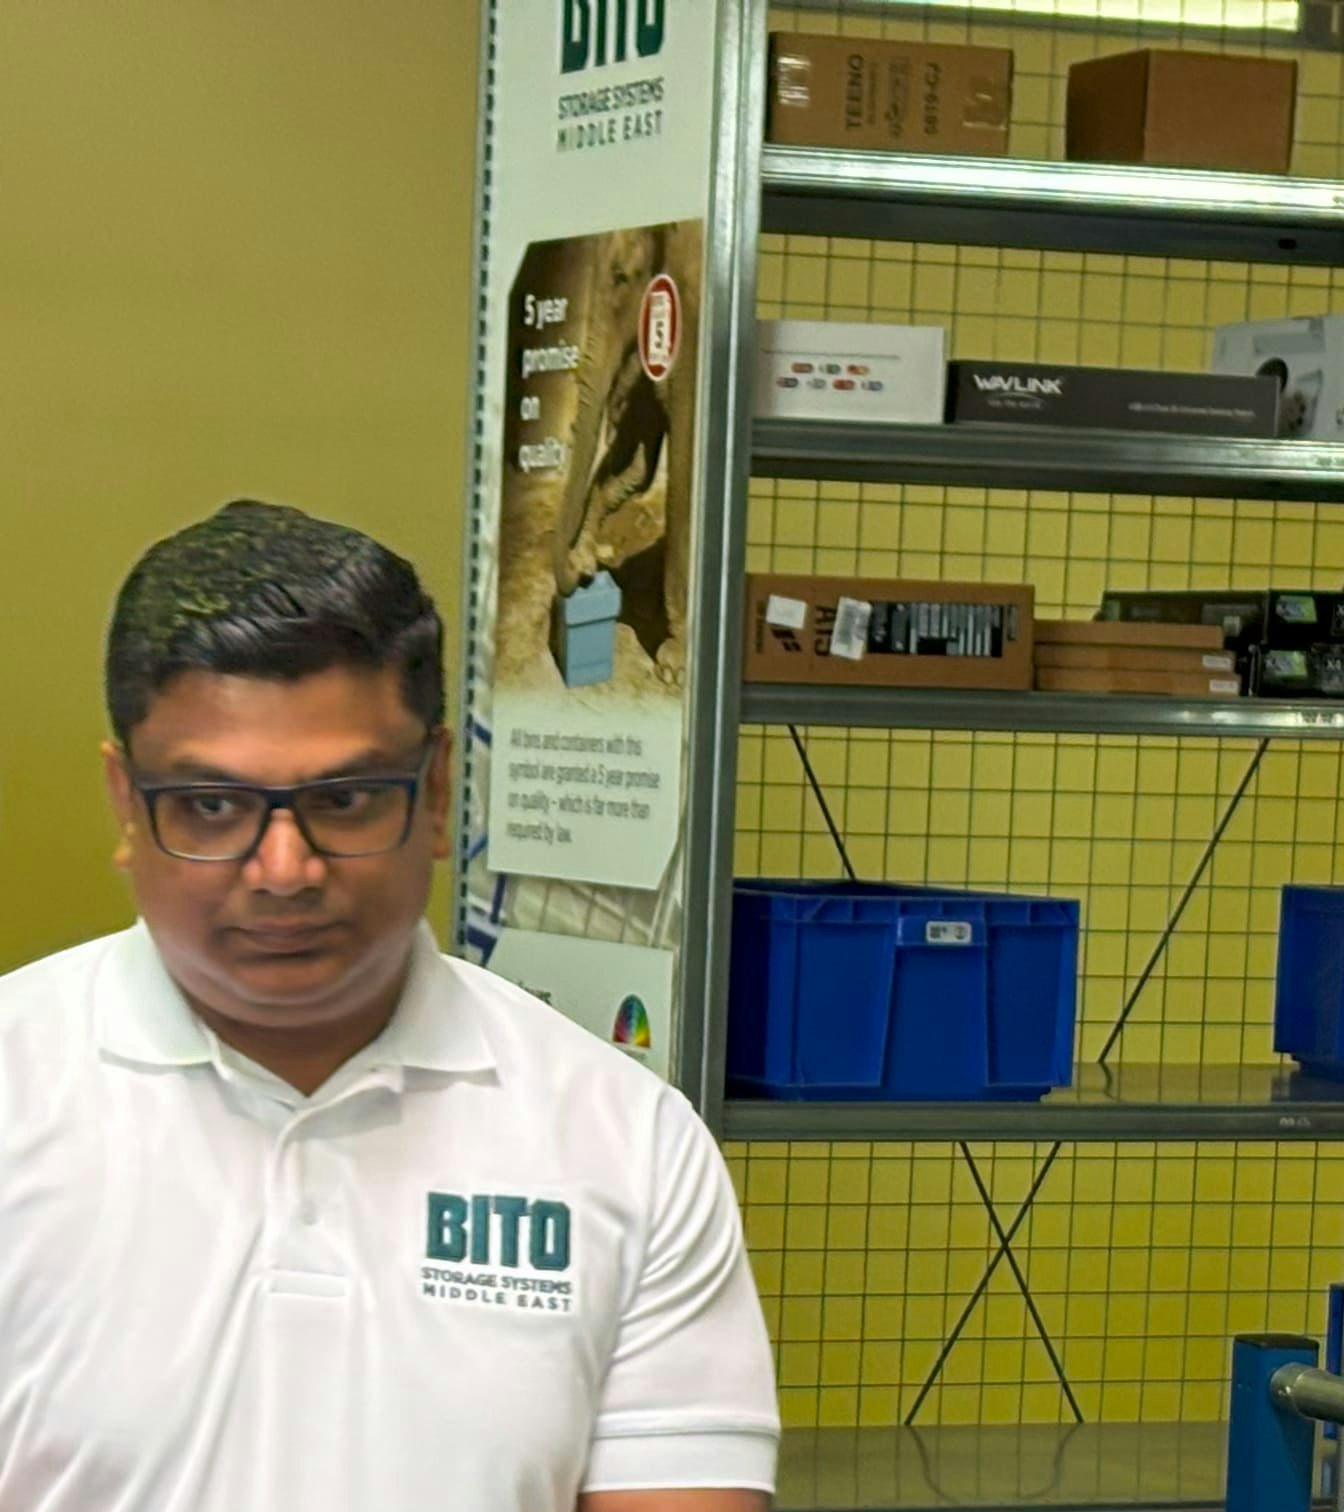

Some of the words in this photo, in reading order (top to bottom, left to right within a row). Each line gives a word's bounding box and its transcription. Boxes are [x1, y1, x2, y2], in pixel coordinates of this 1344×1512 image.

[557, 118, 616, 152] MIDDLE
[624, 109, 662, 140] EAST
[536, 297, 568, 330] year
[522, 339, 580, 379] promise
[520, 396, 541, 420] on
[518, 436, 571, 473] quality
[426, 1191, 571, 1272] BITO
[421, 1266, 497, 1288] STORAGE
[501, 1275, 573, 1295] SYSTEMS
[423, 1283, 506, 1304] MIDDLE
[517, 1294, 572, 1312] EAST
